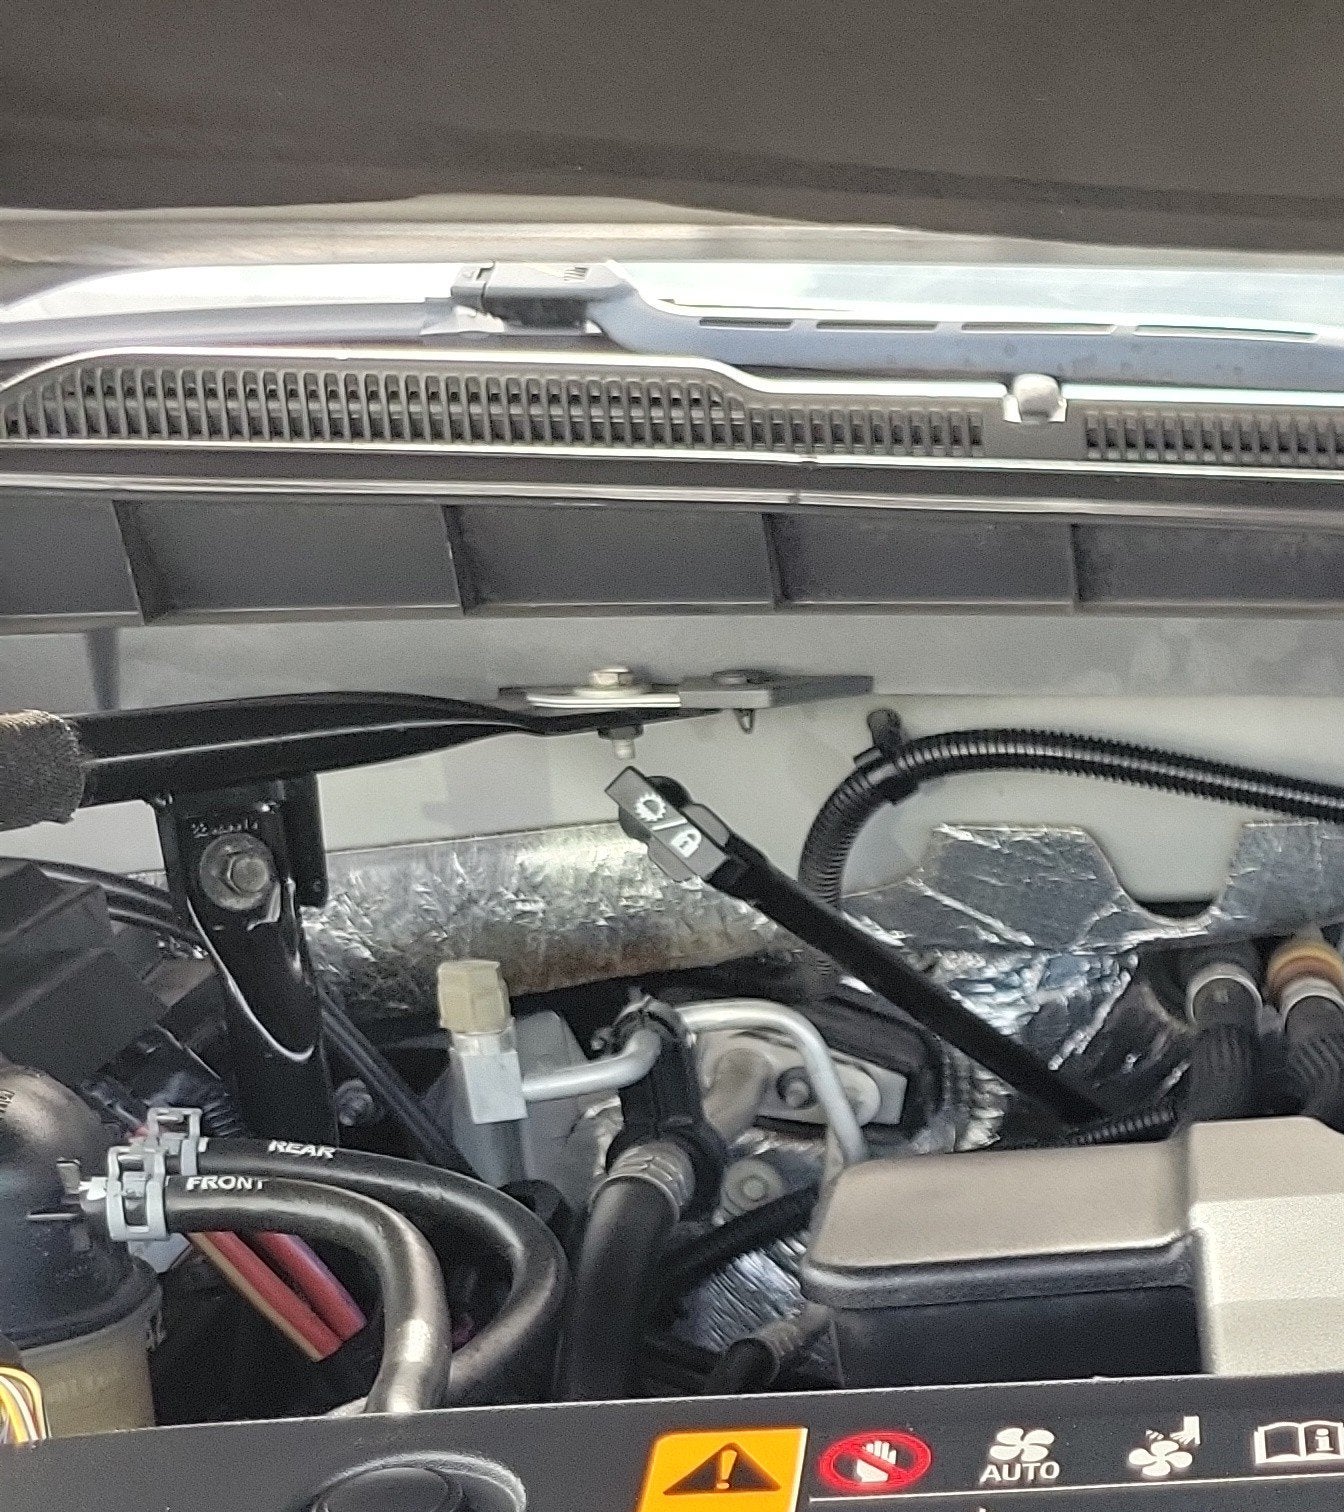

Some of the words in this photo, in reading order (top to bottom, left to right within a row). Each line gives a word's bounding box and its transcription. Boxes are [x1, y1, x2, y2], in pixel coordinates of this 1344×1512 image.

[268, 1139, 337, 1159] REAR
[186, 1176, 272, 1190] FRONT
[979, 1461, 1060, 1483] AUTO
